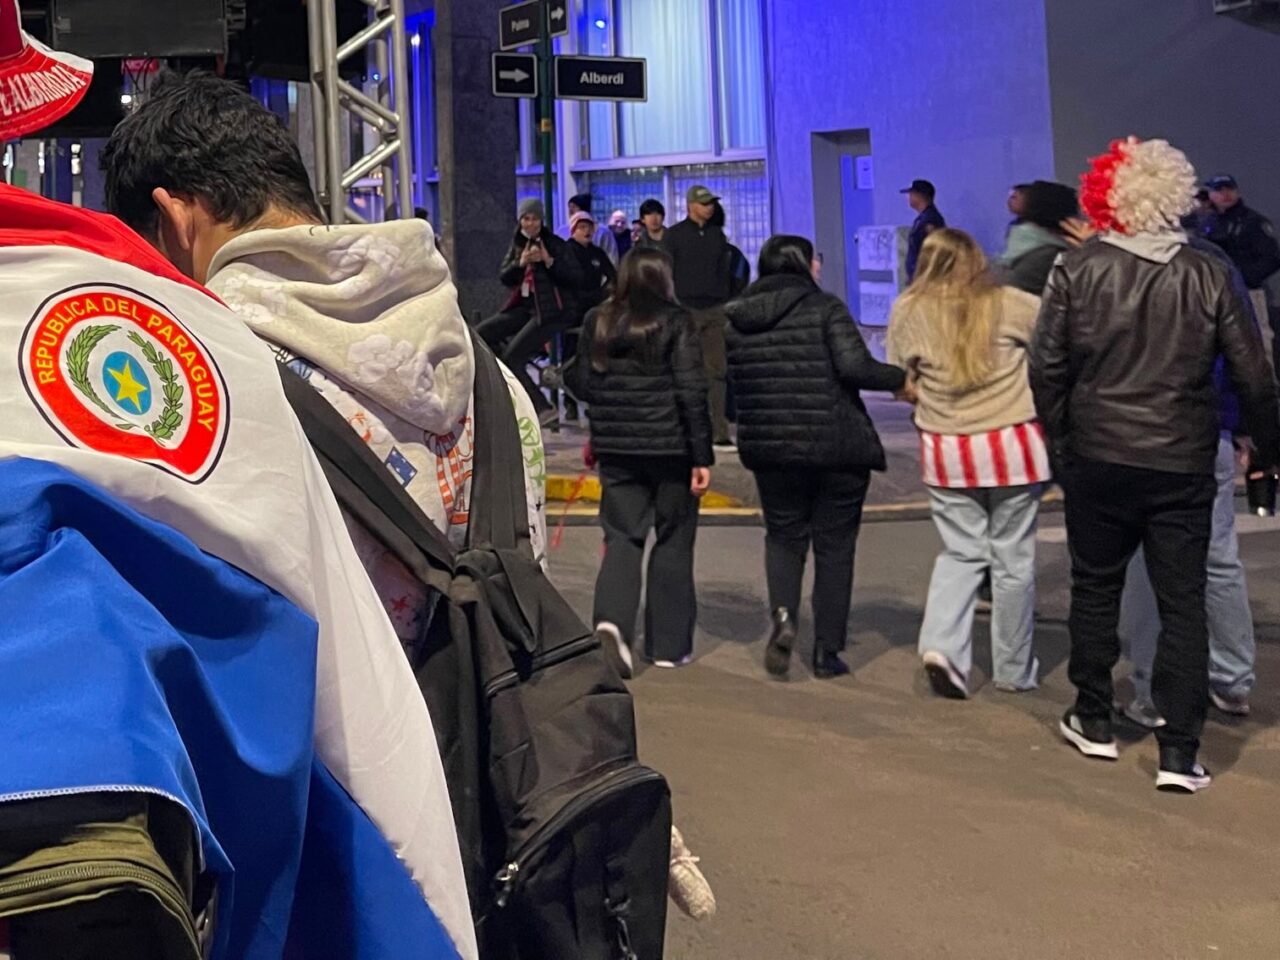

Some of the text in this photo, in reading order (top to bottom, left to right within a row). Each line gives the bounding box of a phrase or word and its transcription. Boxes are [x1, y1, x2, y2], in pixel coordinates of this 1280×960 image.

[579, 71, 624, 86] Alberdi
[35, 296, 214, 433] REPUBLICA DEL PARAGUAY
